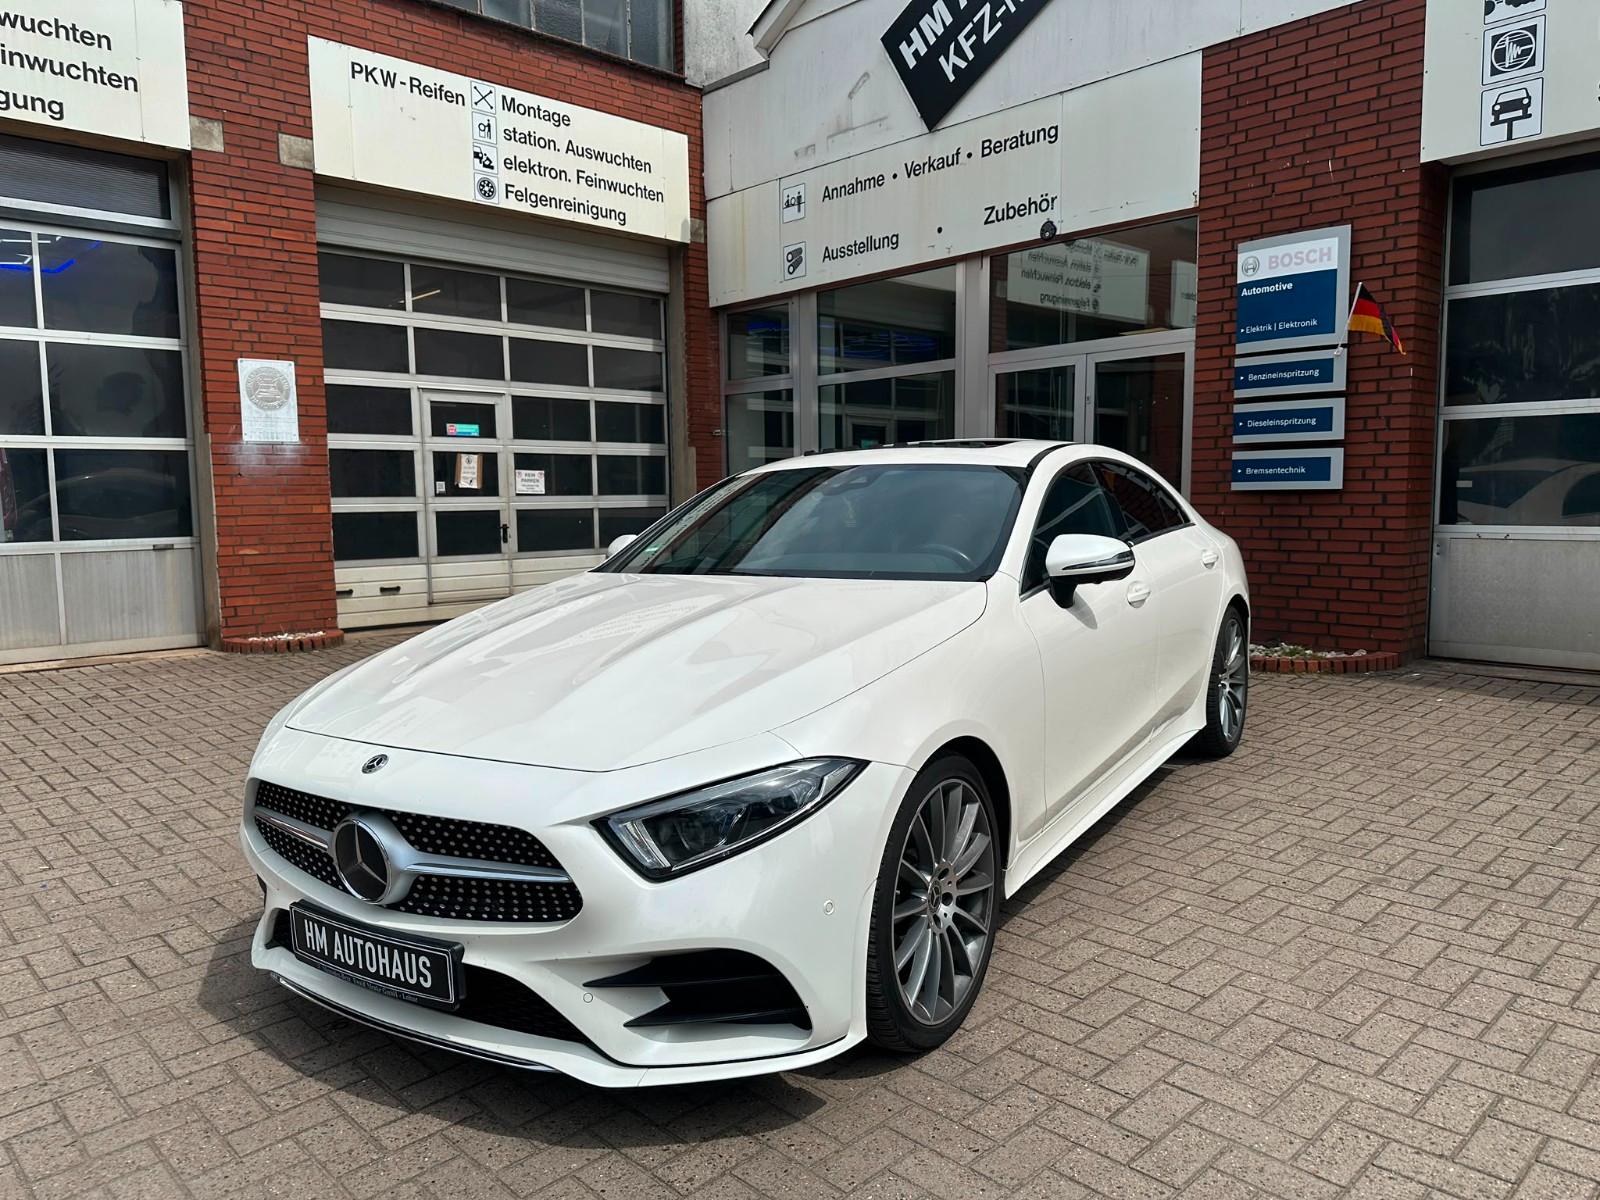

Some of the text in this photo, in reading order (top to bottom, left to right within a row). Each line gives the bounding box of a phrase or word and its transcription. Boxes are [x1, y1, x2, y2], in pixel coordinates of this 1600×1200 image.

[899, 0, 954, 70] HM
[350, 61, 466, 107] PKW-Reifen
[501, 94, 571, 127] Montage
[503, 126, 652, 174] station. Auswuchten
[822, 124, 1060, 203] Annahme Verkauf Beratung
[503, 155, 664, 203] elektron. Feinwuchten
[505, 183, 627, 226] Felgenreinigung
[822, 193, 1058, 263] Ausstellung Zubehör
[1268, 247, 1333, 270] BOSCH
[1241, 281, 1294, 297] Automotive
[1246, 318, 1318, 334] Elektrik Elektronik
[1248, 367, 1320, 382] Benzineinspritzung
[1247, 416, 1317, 429] Dieseleinspritzung
[1246, 465, 1306, 475] Bremsentechnik
[304, 918, 329, 956] HM
[333, 931, 432, 989] AUTOHAUS
